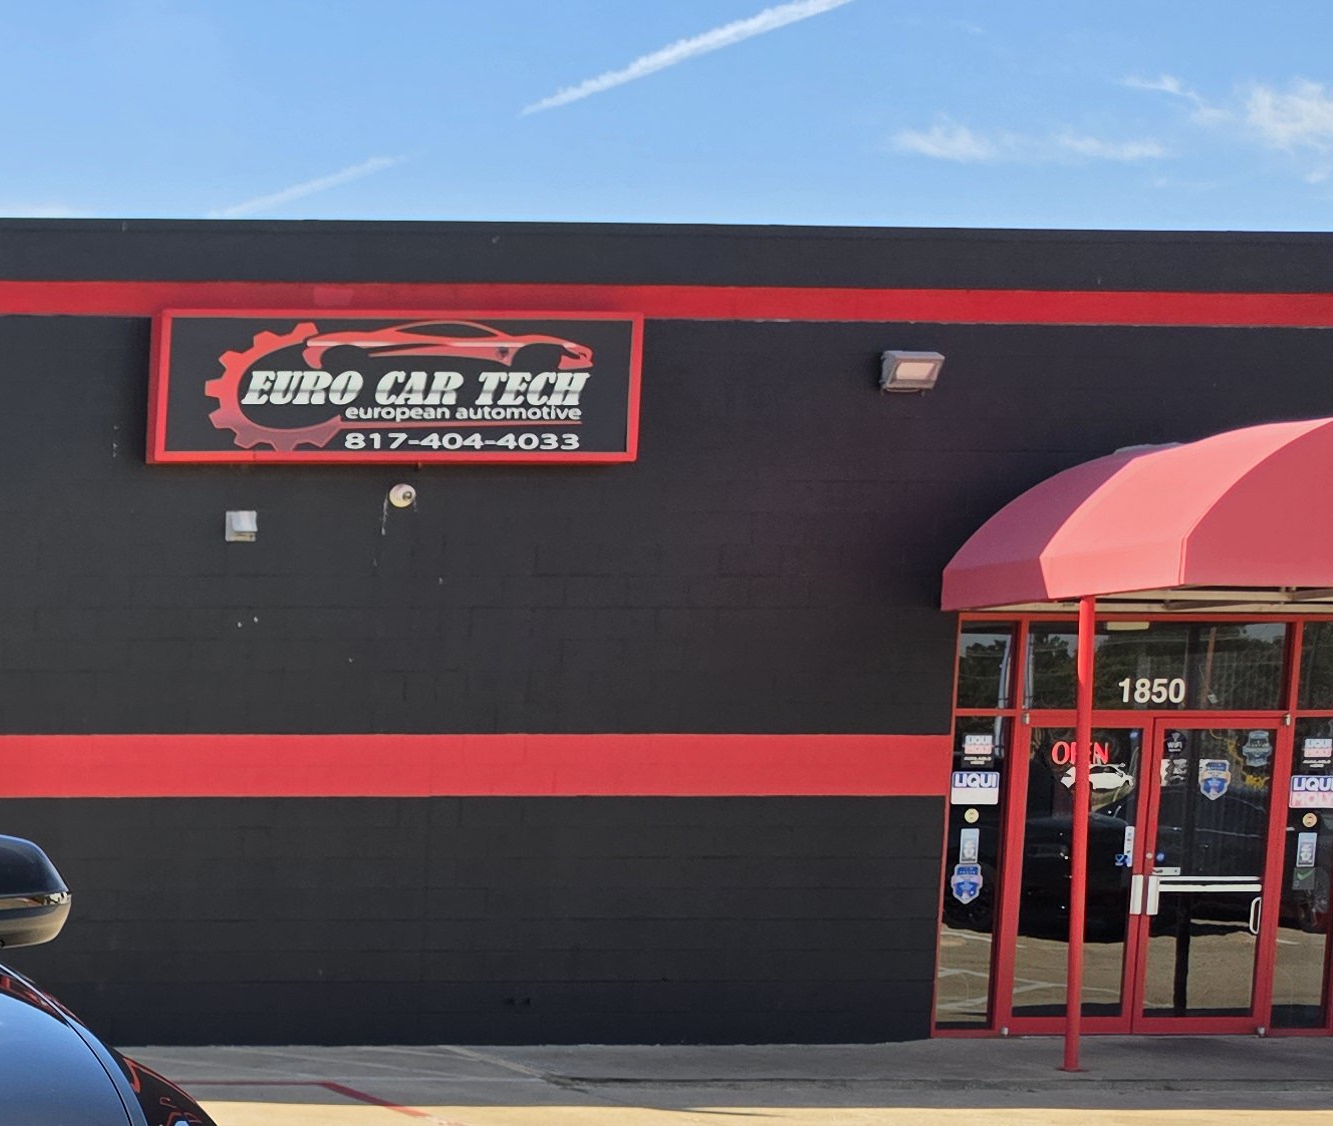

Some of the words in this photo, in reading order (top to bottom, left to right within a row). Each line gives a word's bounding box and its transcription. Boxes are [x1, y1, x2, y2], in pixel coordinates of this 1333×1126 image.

[241, 371, 363, 405] EURO
[375, 371, 464, 405] CAR
[477, 371, 590, 406] TECH
[345, 407, 450, 422] european
[455, 405, 582, 420] automotive
[344, 432, 580, 450] 817-404-4033
[1118, 677, 1186, 703] 1850
[1051, 740, 1110, 765] ON
[954, 773, 998, 788] LIQUI
